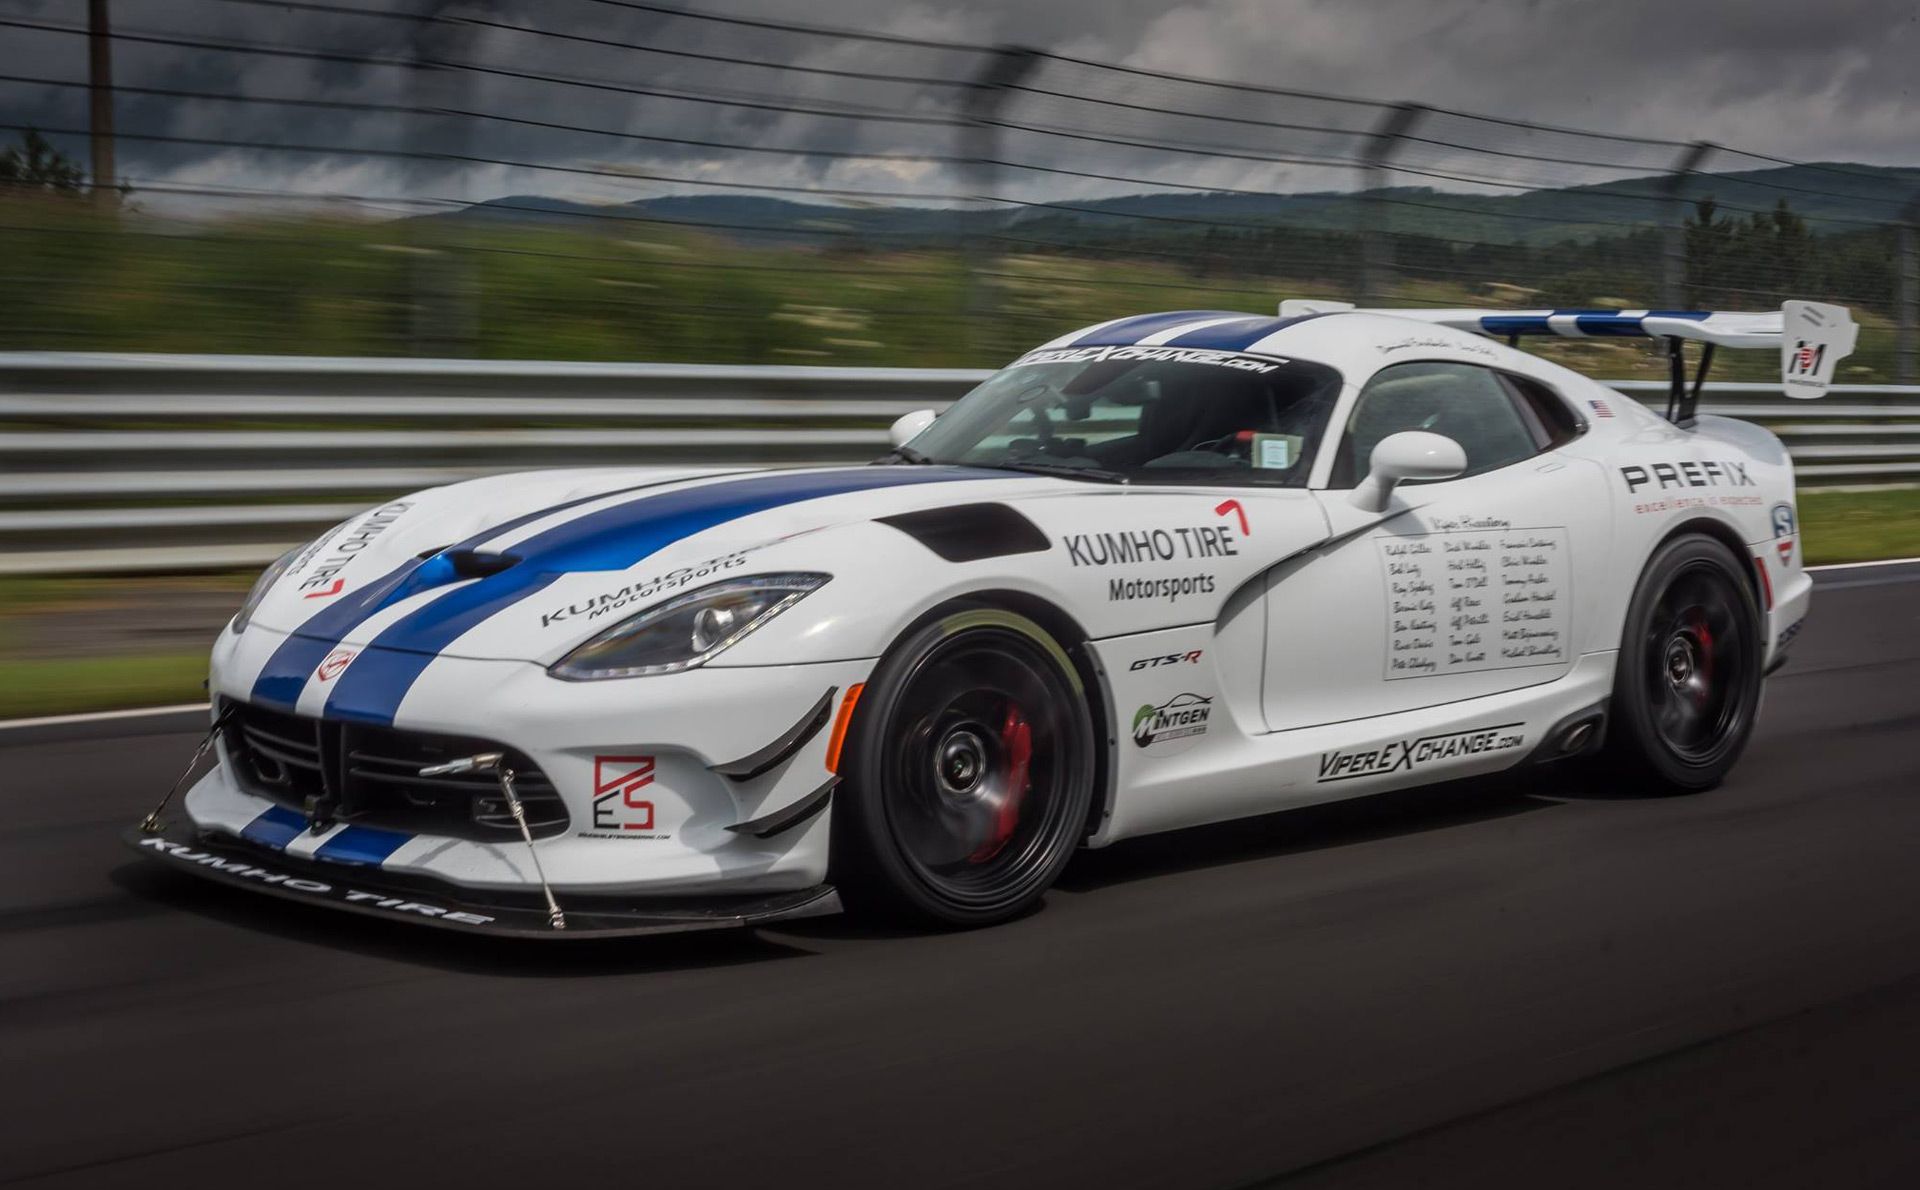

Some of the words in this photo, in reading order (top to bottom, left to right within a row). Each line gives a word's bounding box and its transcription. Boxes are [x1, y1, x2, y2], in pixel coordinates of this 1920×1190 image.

[1619, 461, 1757, 493] PREFIX
[338, 502, 416, 552] KUMHO
[1063, 529, 1174, 566] KUMHO
[1175, 526, 1239, 558] TIRE
[299, 553, 356, 591] TIRE
[588, 557, 747, 620] Motorsports
[1109, 573, 1215, 602] Motorsports
[541, 567, 693, 627] KUMHO
[1129, 649, 1203, 671] GTS-R
[1319, 732, 1525, 778] VIPEREXCHANGE.COM
[140, 837, 333, 893] KUMHO
[345, 890, 496, 925] TIRE
